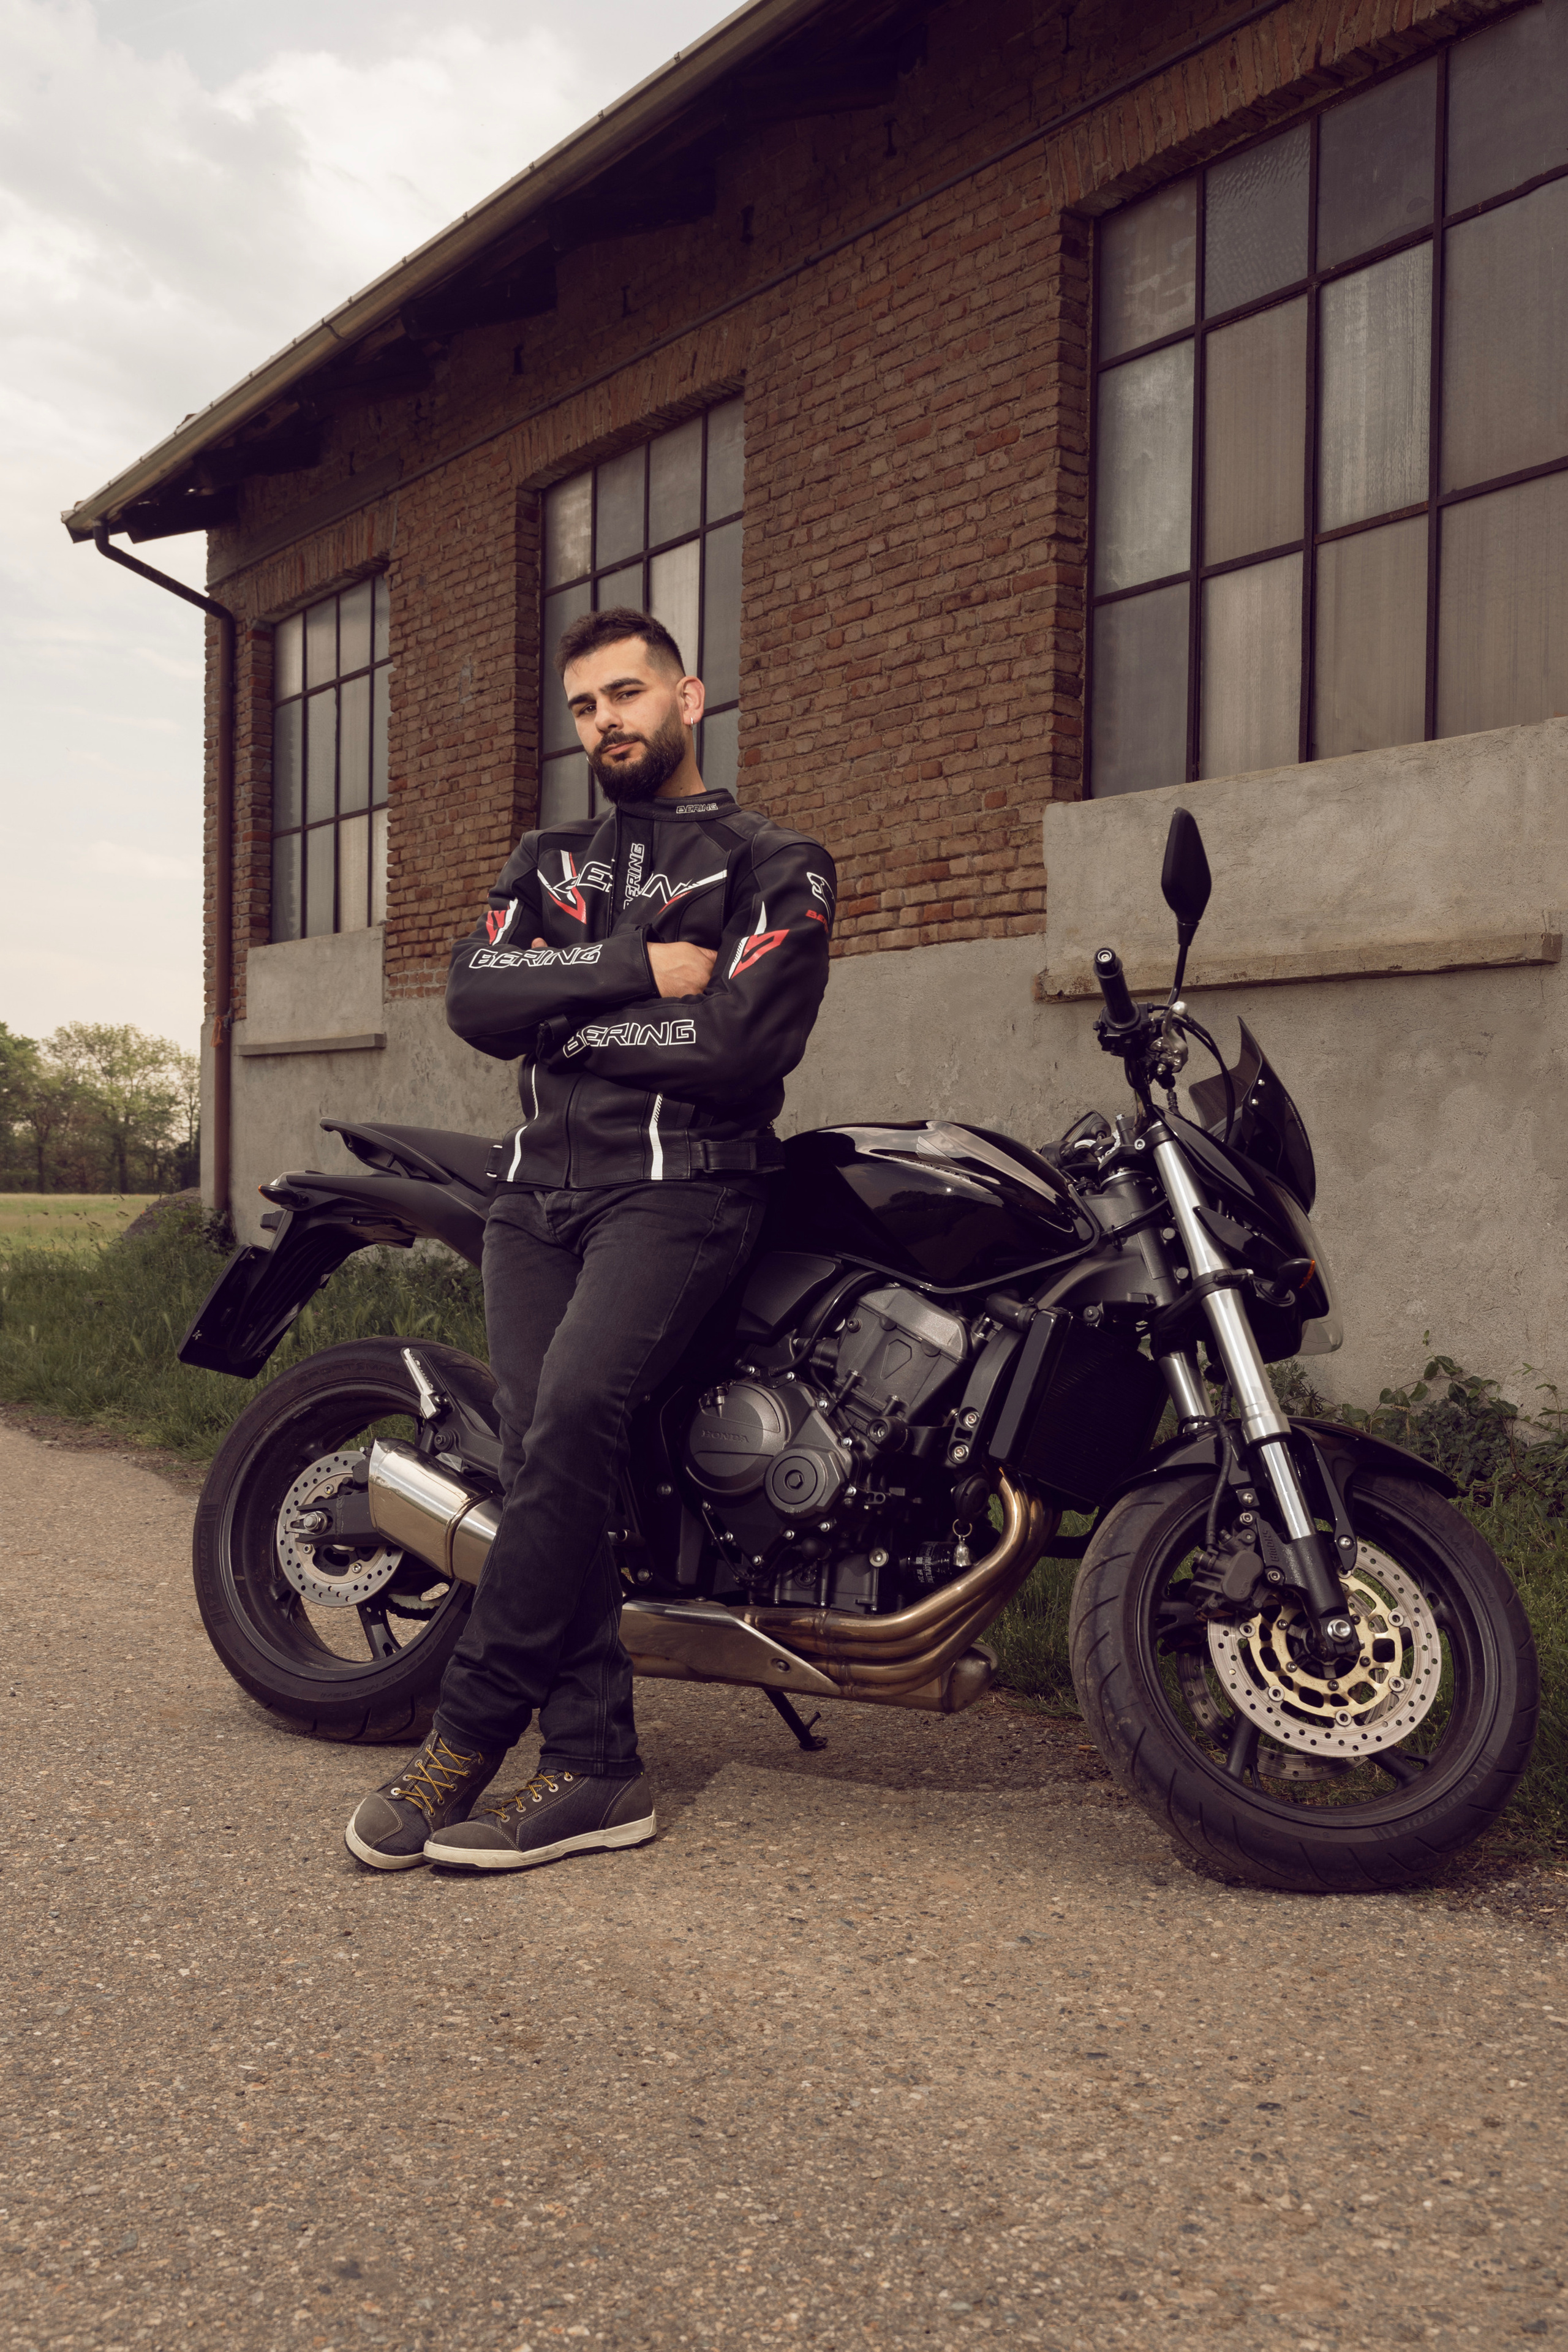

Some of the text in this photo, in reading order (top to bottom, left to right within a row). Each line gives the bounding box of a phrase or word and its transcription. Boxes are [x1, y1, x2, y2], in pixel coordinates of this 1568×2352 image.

[676, 803, 718, 814] BERING
[469, 944, 603, 969] BERING
[562, 1019, 696, 1058] BERING
[701, 1430, 749, 1443] HONDA
